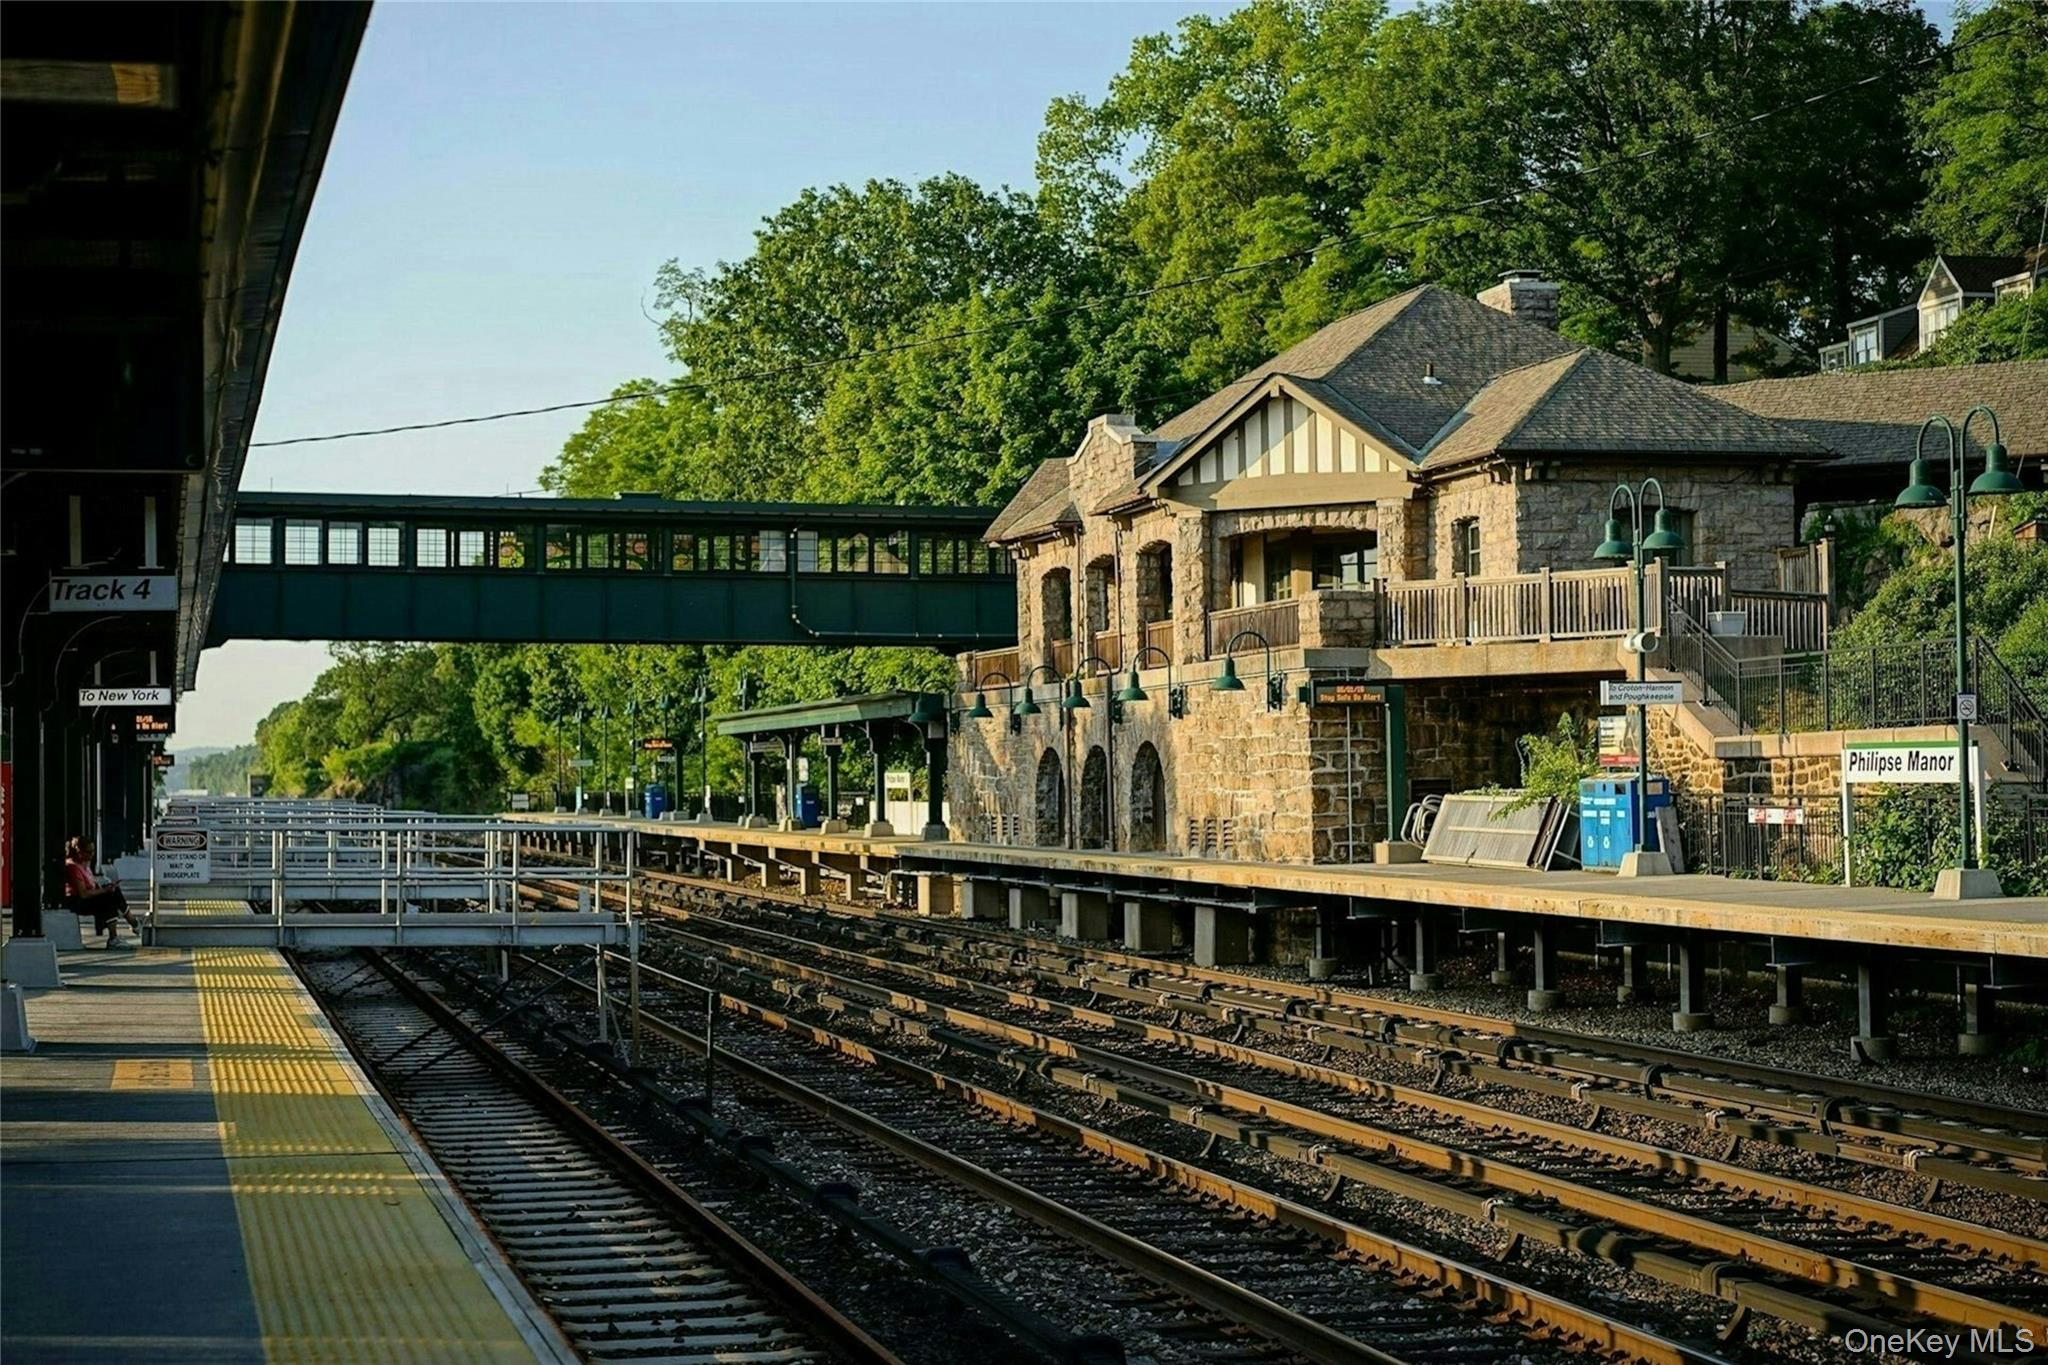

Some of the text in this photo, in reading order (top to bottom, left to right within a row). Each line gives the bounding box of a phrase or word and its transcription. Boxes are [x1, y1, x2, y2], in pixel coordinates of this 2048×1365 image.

[51, 579, 151, 600] Track 4
[1618, 684, 1674, 692] Croton-Harmon
[81, 689, 159, 701] To New York
[1624, 693, 1674, 701] Poughkeepsie
[1849, 750, 1954, 776] Philipse Manor
[163, 835, 200, 847] WARNING
